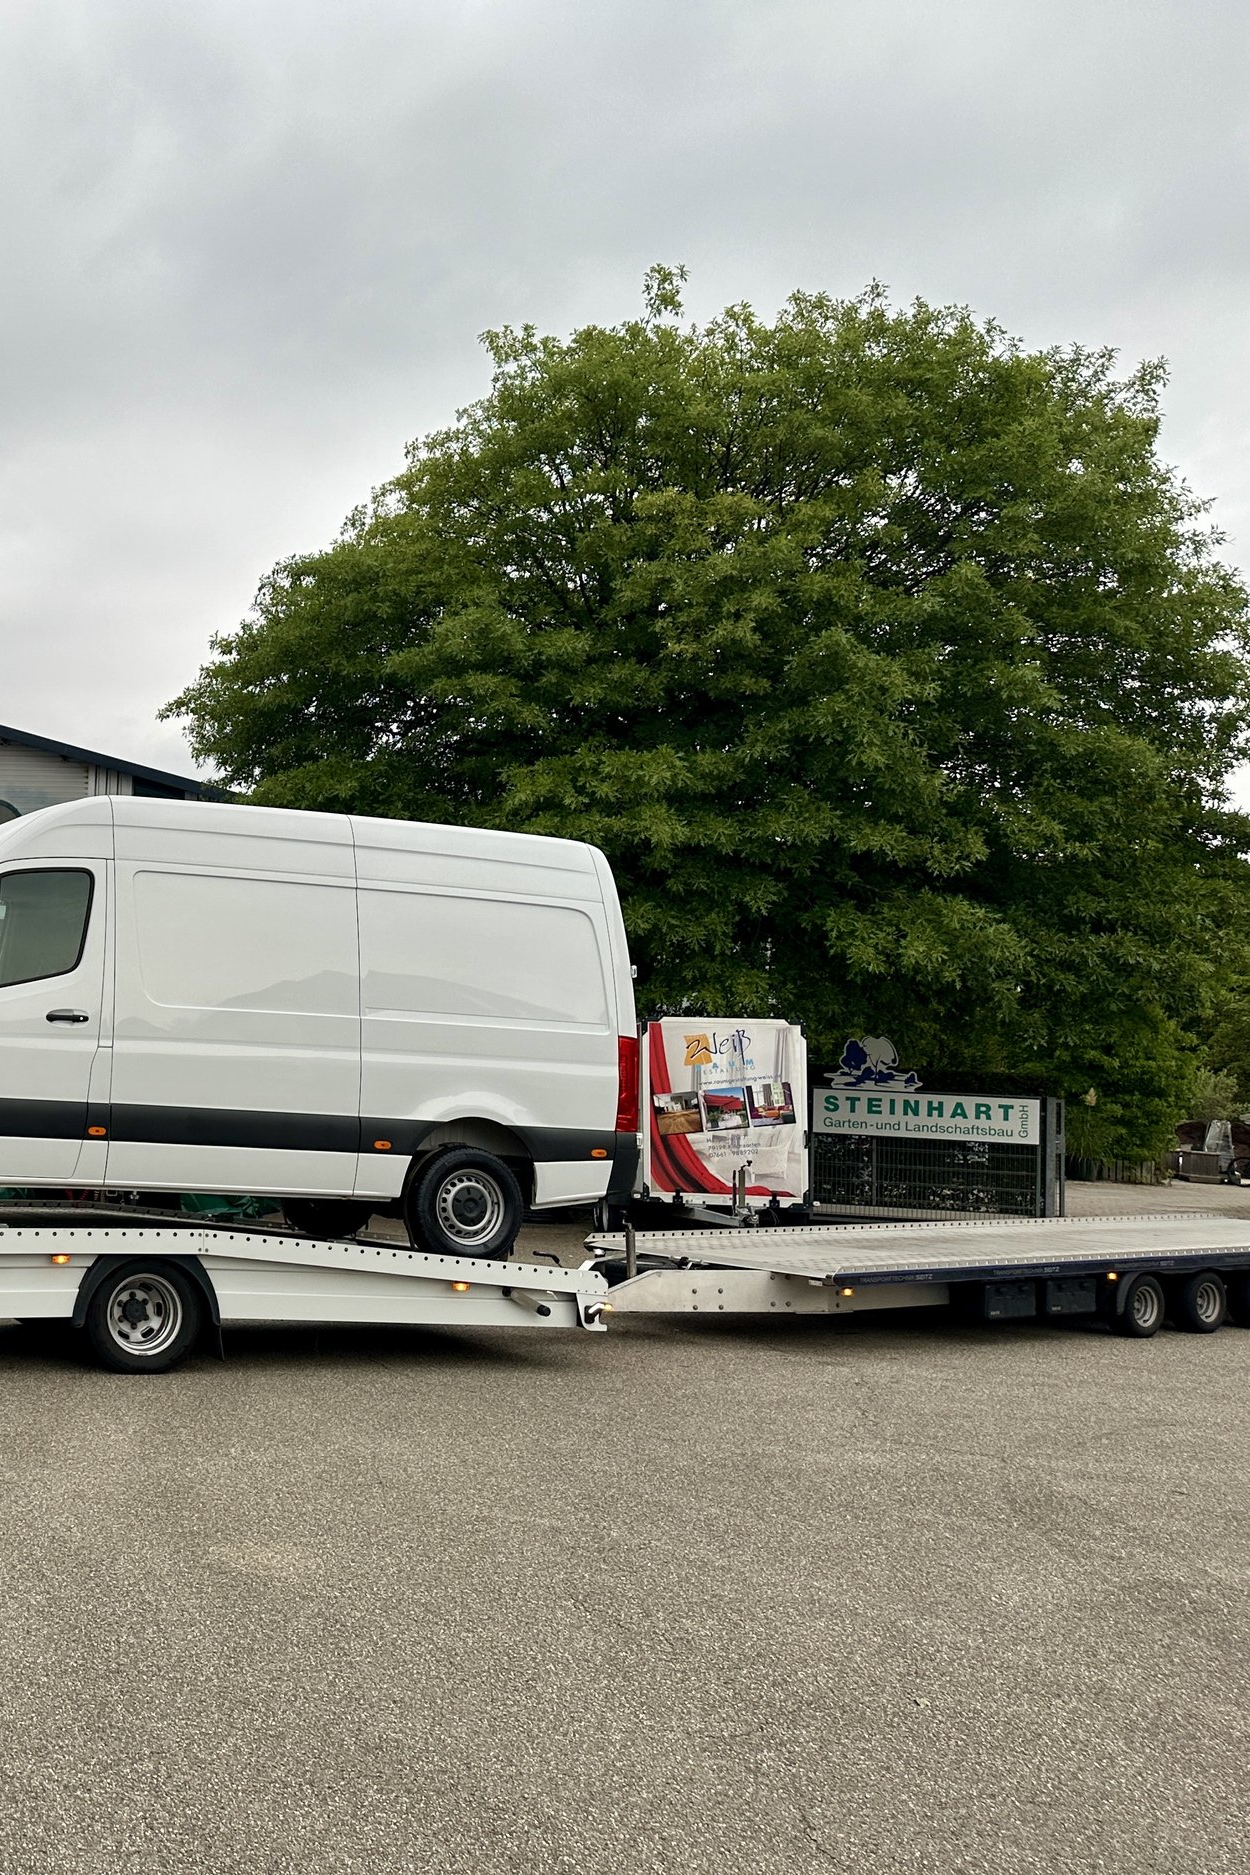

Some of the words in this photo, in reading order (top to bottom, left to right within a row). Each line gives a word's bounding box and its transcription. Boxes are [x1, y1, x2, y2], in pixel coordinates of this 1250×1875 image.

[697, 1064, 756, 1076] ESTALUNG
[823, 1095, 1014, 1122] STEINHART
[905, 1121, 1014, 1137] Landschaftsbau
[1018, 1104, 1029, 1138] GmbH
